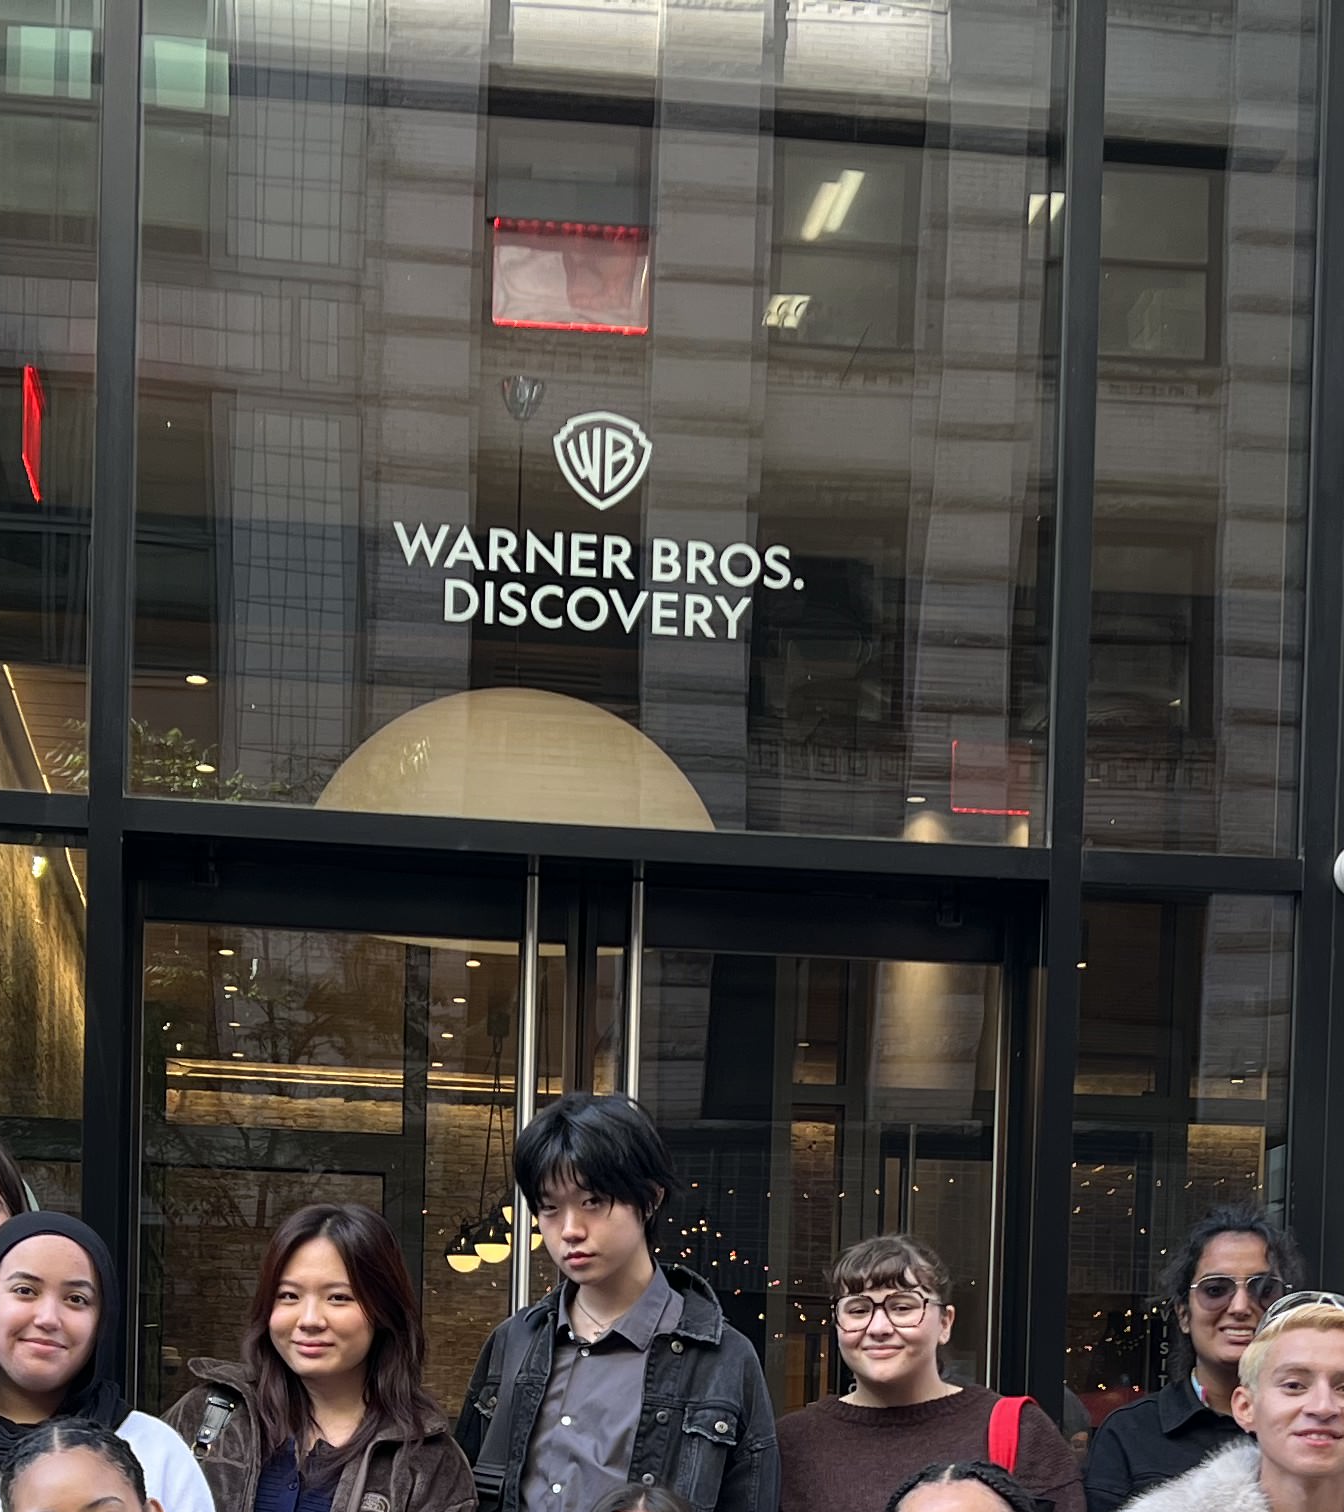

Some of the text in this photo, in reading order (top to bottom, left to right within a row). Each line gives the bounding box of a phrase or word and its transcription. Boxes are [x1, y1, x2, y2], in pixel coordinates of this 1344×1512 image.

[566, 427, 635, 494] WB
[393, 521, 805, 591] WARNER BROS.
[443, 578, 751, 640] DISCOVERY
